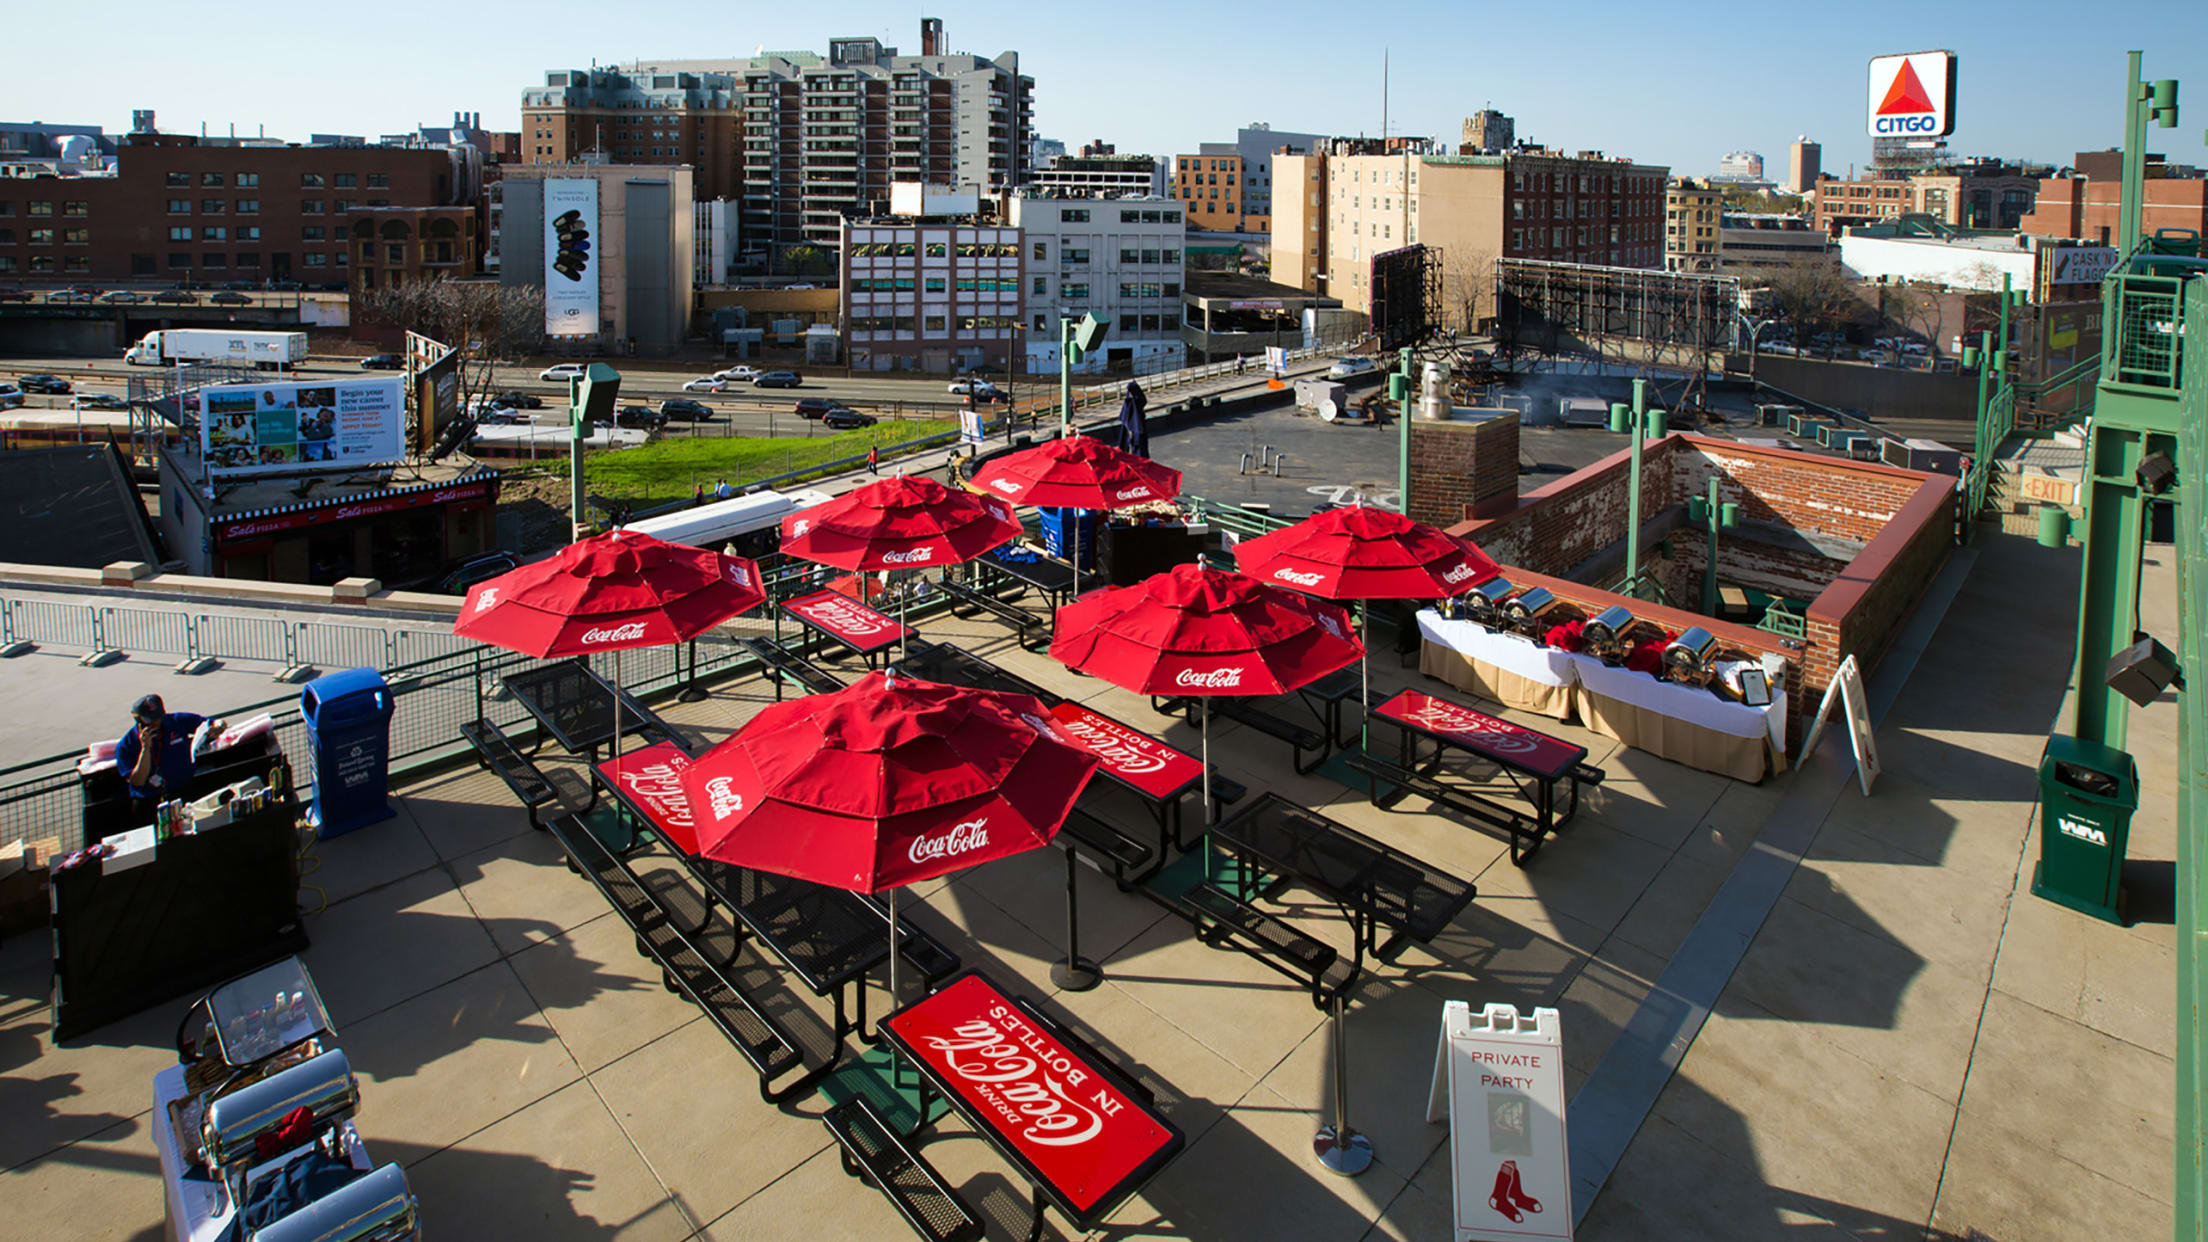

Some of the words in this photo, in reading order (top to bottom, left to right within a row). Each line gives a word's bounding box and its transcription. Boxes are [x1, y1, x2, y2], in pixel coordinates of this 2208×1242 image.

[1876, 115, 1936, 133] CITGO
[2072, 252, 2100, 266] CASK
[2032, 478, 2066, 502] EXIT
[1176, 667, 1245, 688] Coca-Cola
[1156, 749, 1177, 761] IN
[908, 817, 990, 865] Coca-Cola
[2058, 817, 2107, 844] WM
[1471, 1051, 1542, 1068] PRIVATE
[920, 1018, 1104, 1147] Coca-Cola
[1480, 1074, 1535, 1090] PARTY
[973, 1083, 1024, 1125] DRINK
[1090, 1089, 1125, 1118] IN
